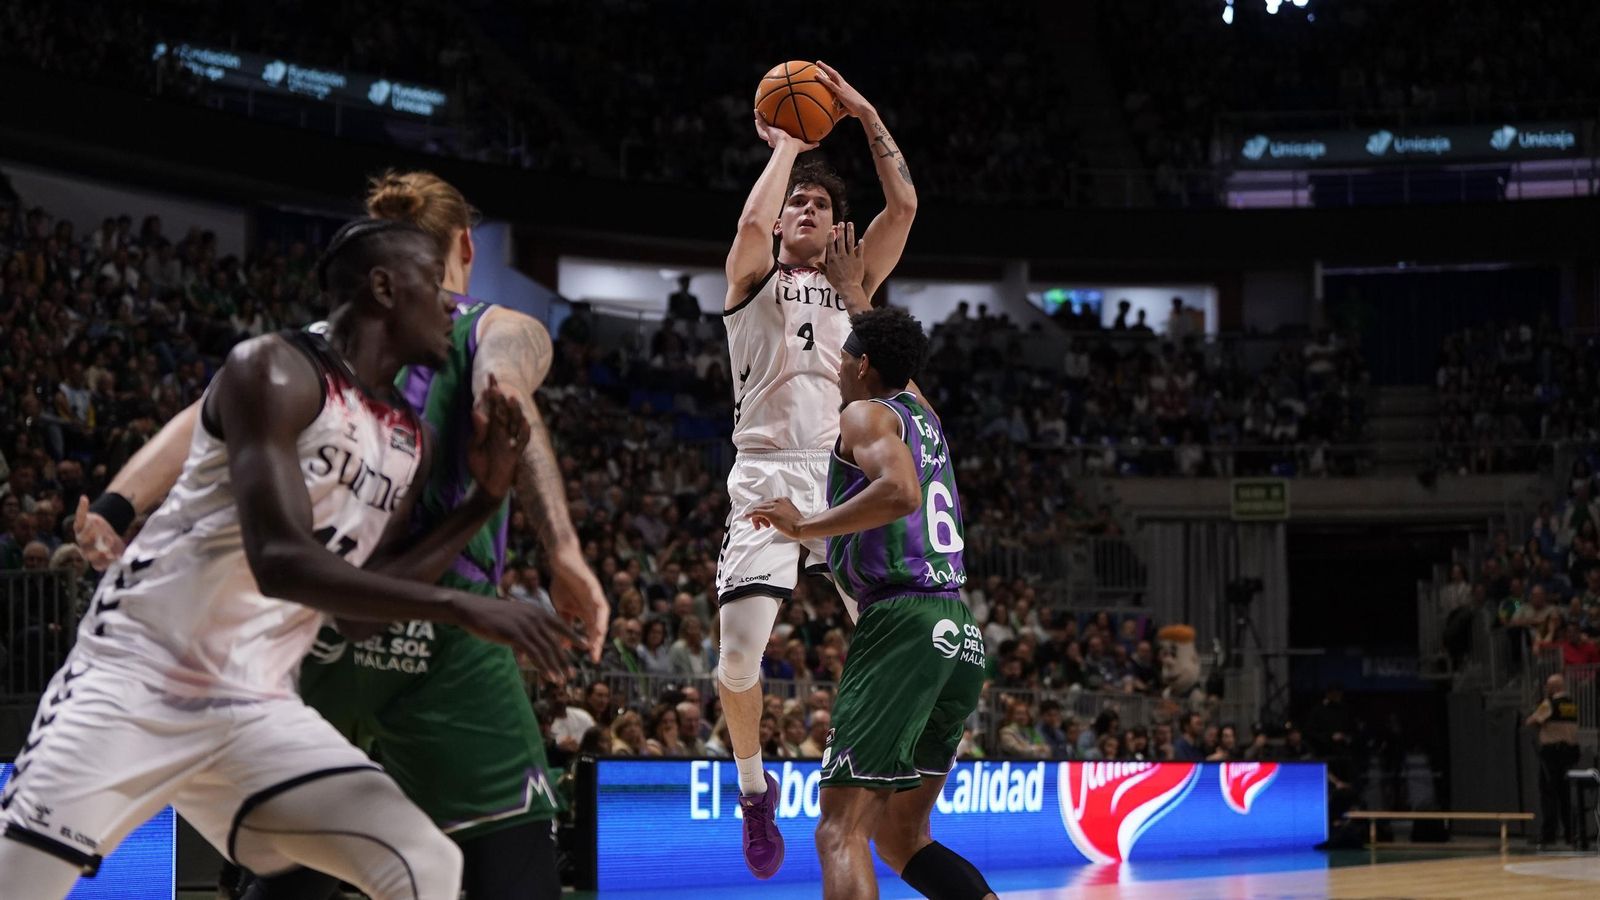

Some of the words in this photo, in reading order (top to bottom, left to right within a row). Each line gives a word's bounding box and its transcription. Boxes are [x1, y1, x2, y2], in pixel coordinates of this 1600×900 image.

[1269, 141, 1326, 160] Unicaja
[1393, 135, 1450, 155] Unicaja
[1517, 131, 1575, 149] Unicaja
[776, 283, 847, 312] urne
[797, 322, 815, 351] 9
[926, 481, 964, 553] 6
[388, 620, 435, 641] STA
[389, 637, 432, 658] SOL
[964, 638, 980, 652] DEL
[960, 651, 986, 669] MÁLAG
[690, 760, 721, 820] El
